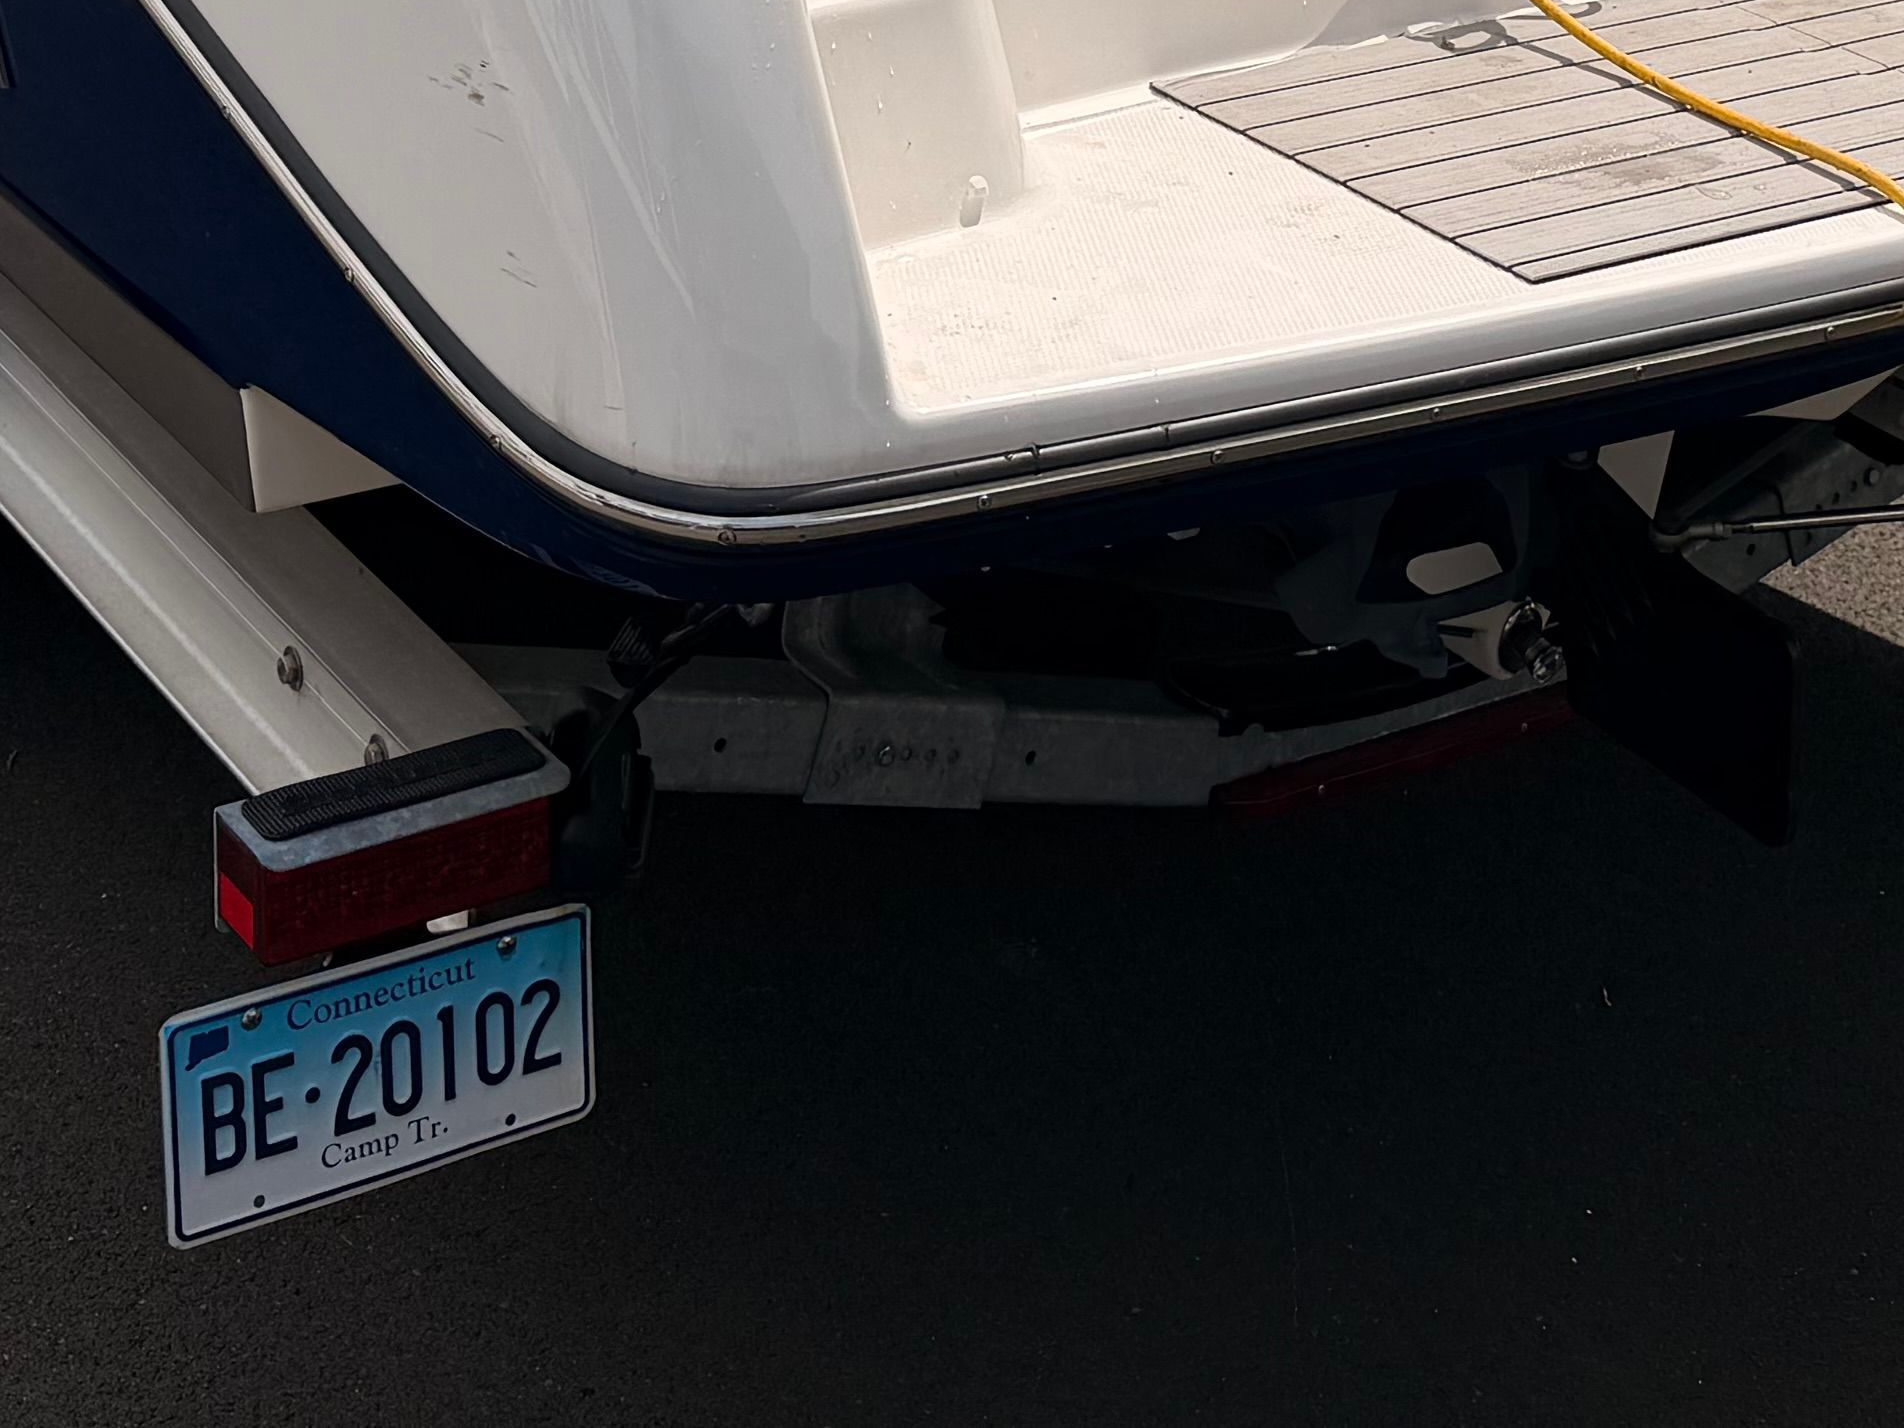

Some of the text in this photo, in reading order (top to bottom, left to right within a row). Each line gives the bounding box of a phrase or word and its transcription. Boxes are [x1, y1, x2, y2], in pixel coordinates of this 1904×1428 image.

[286, 958, 476, 1031] Connecticut
[321, 1116, 449, 1169] Camp Tr.
